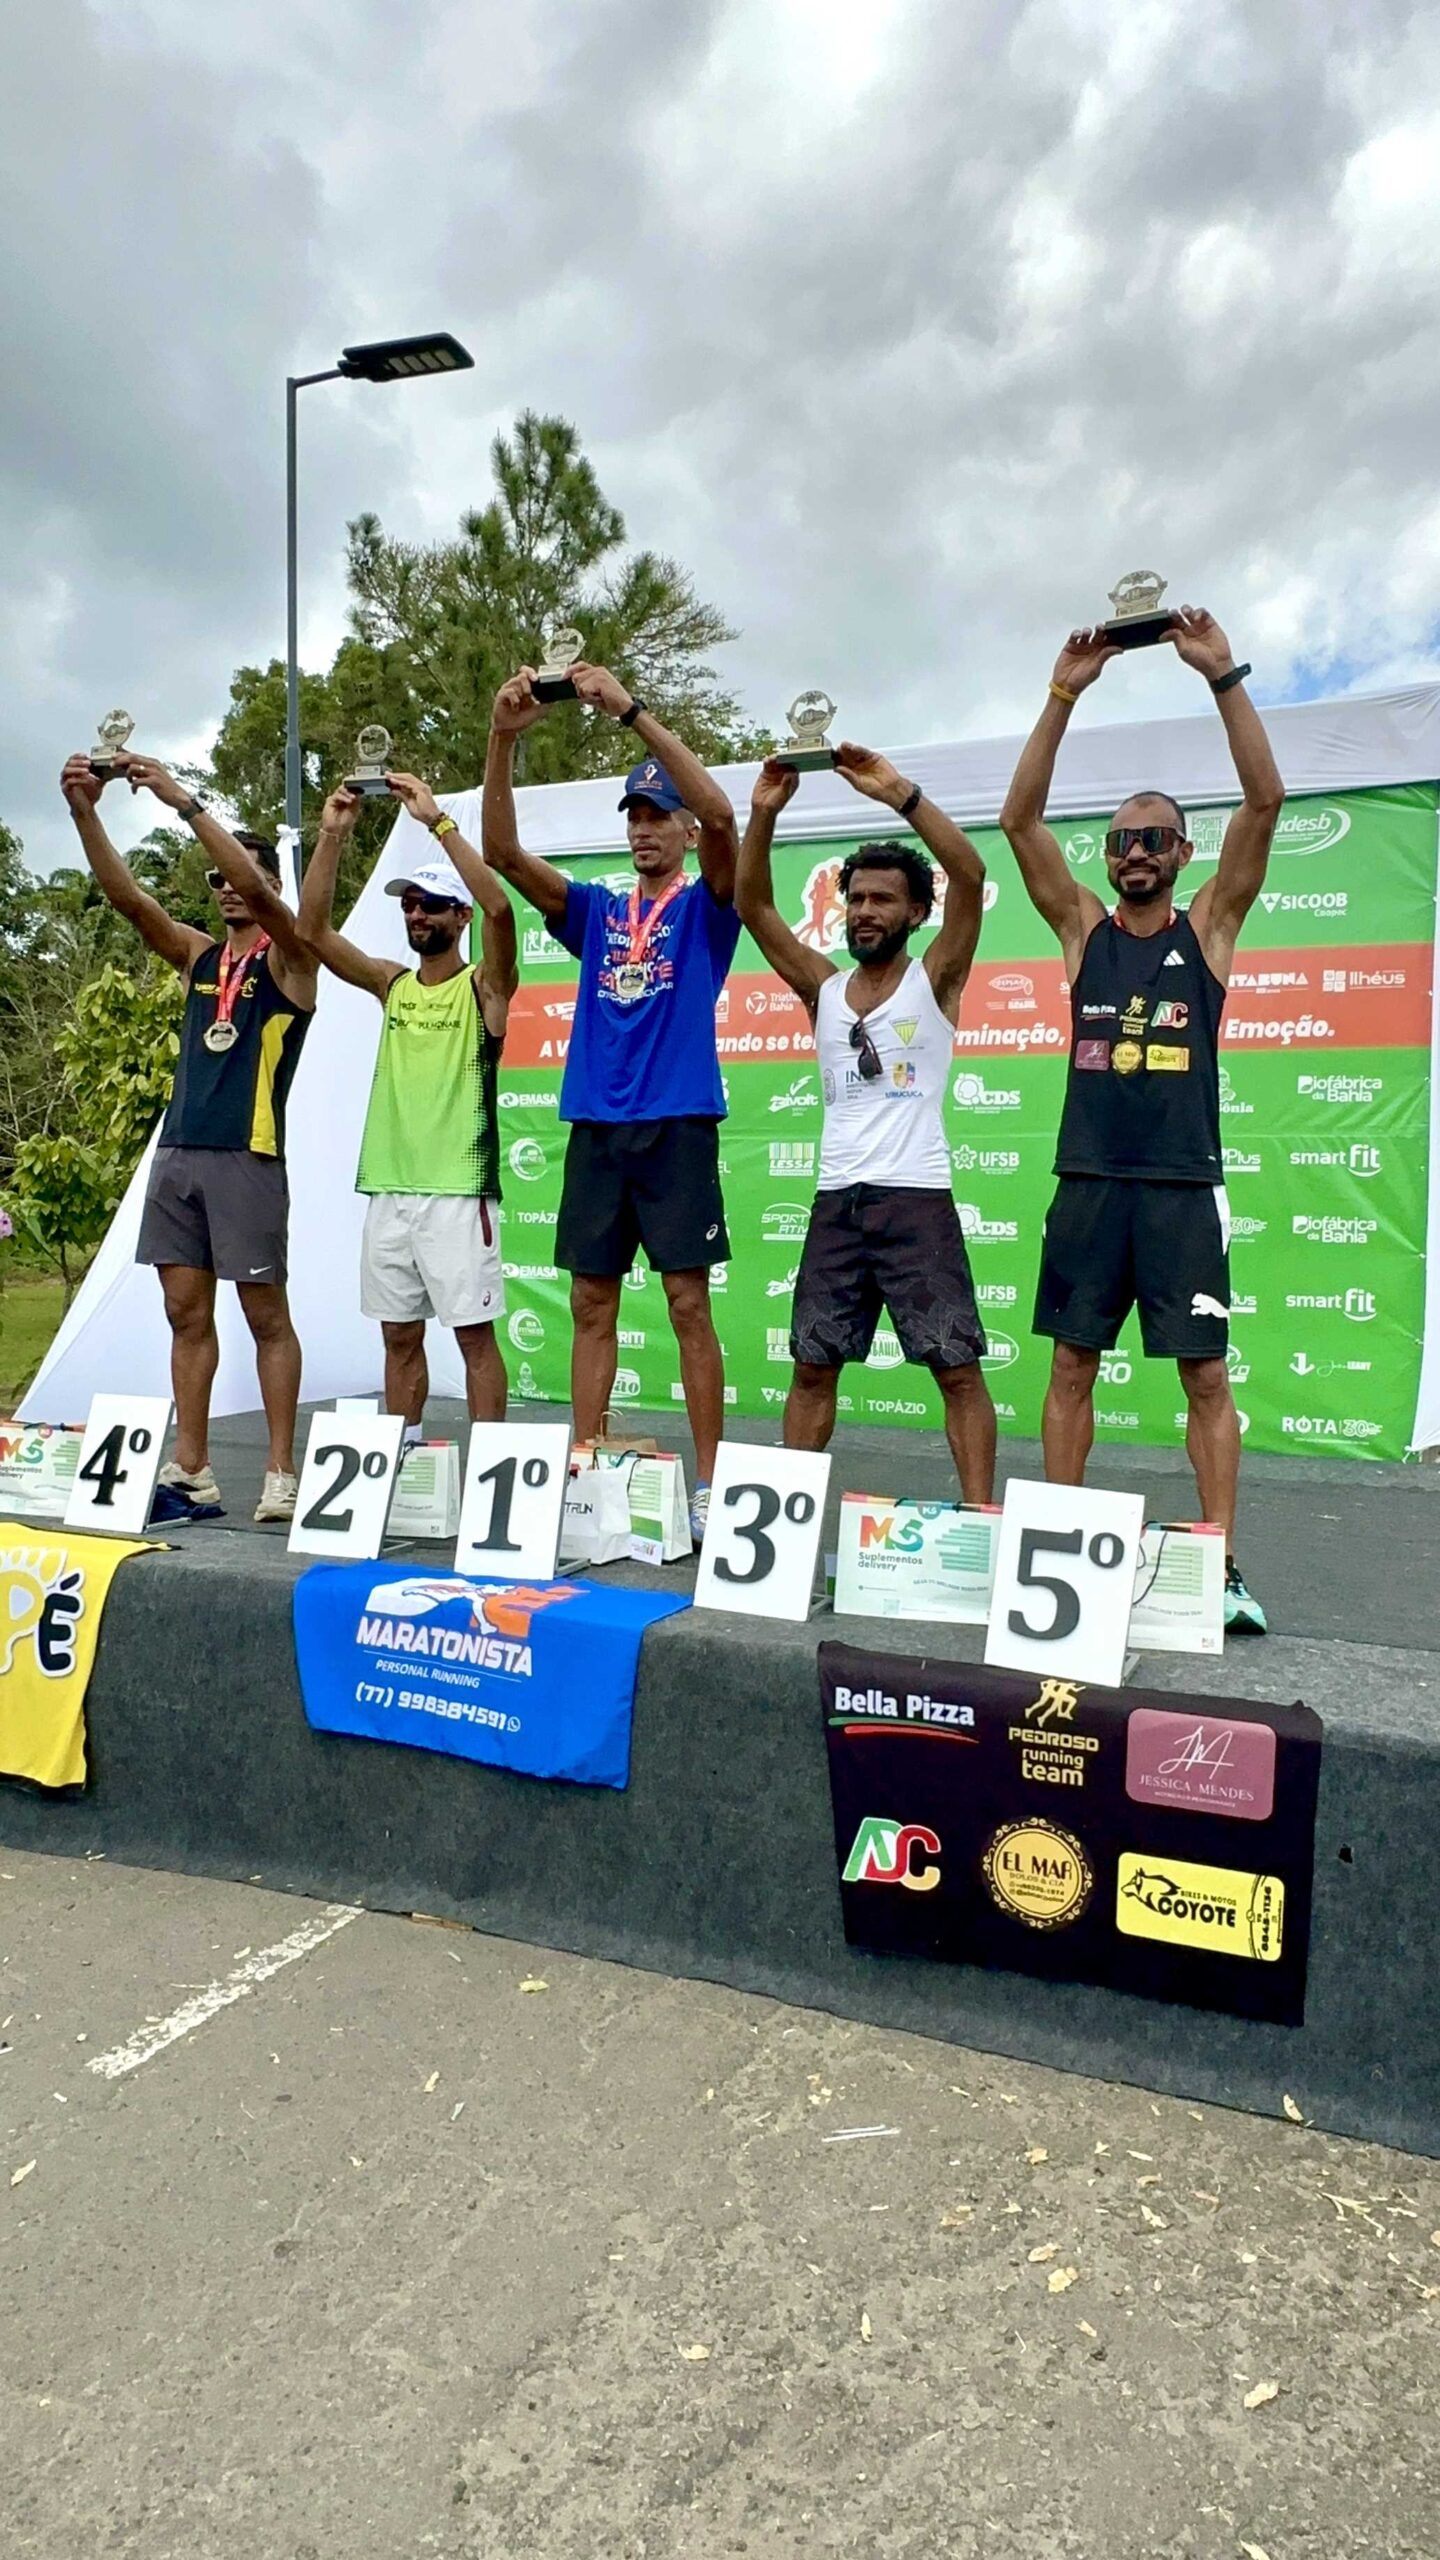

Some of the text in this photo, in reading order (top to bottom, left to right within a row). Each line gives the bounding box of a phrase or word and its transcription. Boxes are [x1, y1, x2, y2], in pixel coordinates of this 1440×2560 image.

[1281, 892, 1348, 911] SICOOB
[1350, 971, 1405, 986] Ilhéus
[954, 1022, 1066, 1052] minação,
[1224, 1014, 1336, 1046] Emoção.
[716, 1033, 763, 1052] ando
[765, 1035, 790, 1051] se
[1297, 1074, 1383, 1094] Biofábrica
[520, 1094, 558, 1106] EMASA
[1327, 1089, 1373, 1103] Bahia
[769, 1159, 814, 1170] LESSA
[979, 1151, 1020, 1168] UFSB
[1290, 1143, 1380, 1169] smart fit
[517, 1209, 559, 1225] TOPÁZI
[761, 1213, 809, 1224] SPORT
[1292, 1215, 1377, 1234] Biofábrica
[1321, 1229, 1368, 1244] Bahia
[519, 1265, 557, 1279] EMASA
[976, 1284, 1017, 1301] UFSB
[1285, 1287, 1376, 1313] smart fit
[618, 1331, 646, 1345] RITI
[867, 1398, 927, 1415] TOPÁZIO
[1281, 1415, 1338, 1435] ROTA
[859, 1515, 924, 1553] MS
[858, 1551, 924, 1565] Suplementos
[858, 1560, 897, 1572] delivery
[356, 1616, 533, 1677] MARATONISTA
[375, 1659, 481, 1689] PERSONAL RUNNING
[355, 1681, 394, 1708] (77)
[835, 1686, 976, 1727] Bella Pizza
[1008, 1726, 1100, 1753] PEDROSO
[1022, 1749, 1084, 1770] running
[1022, 1759, 1084, 1787] team
[1138, 1774, 1191, 1792] JESSICA
[1199, 1783, 1255, 1801] MENDES
[1003, 1851, 1073, 1881] EL MAR
[1210, 1895, 1237, 1906] MOTOS
[1158, 1896, 1237, 1928] COYOTE
